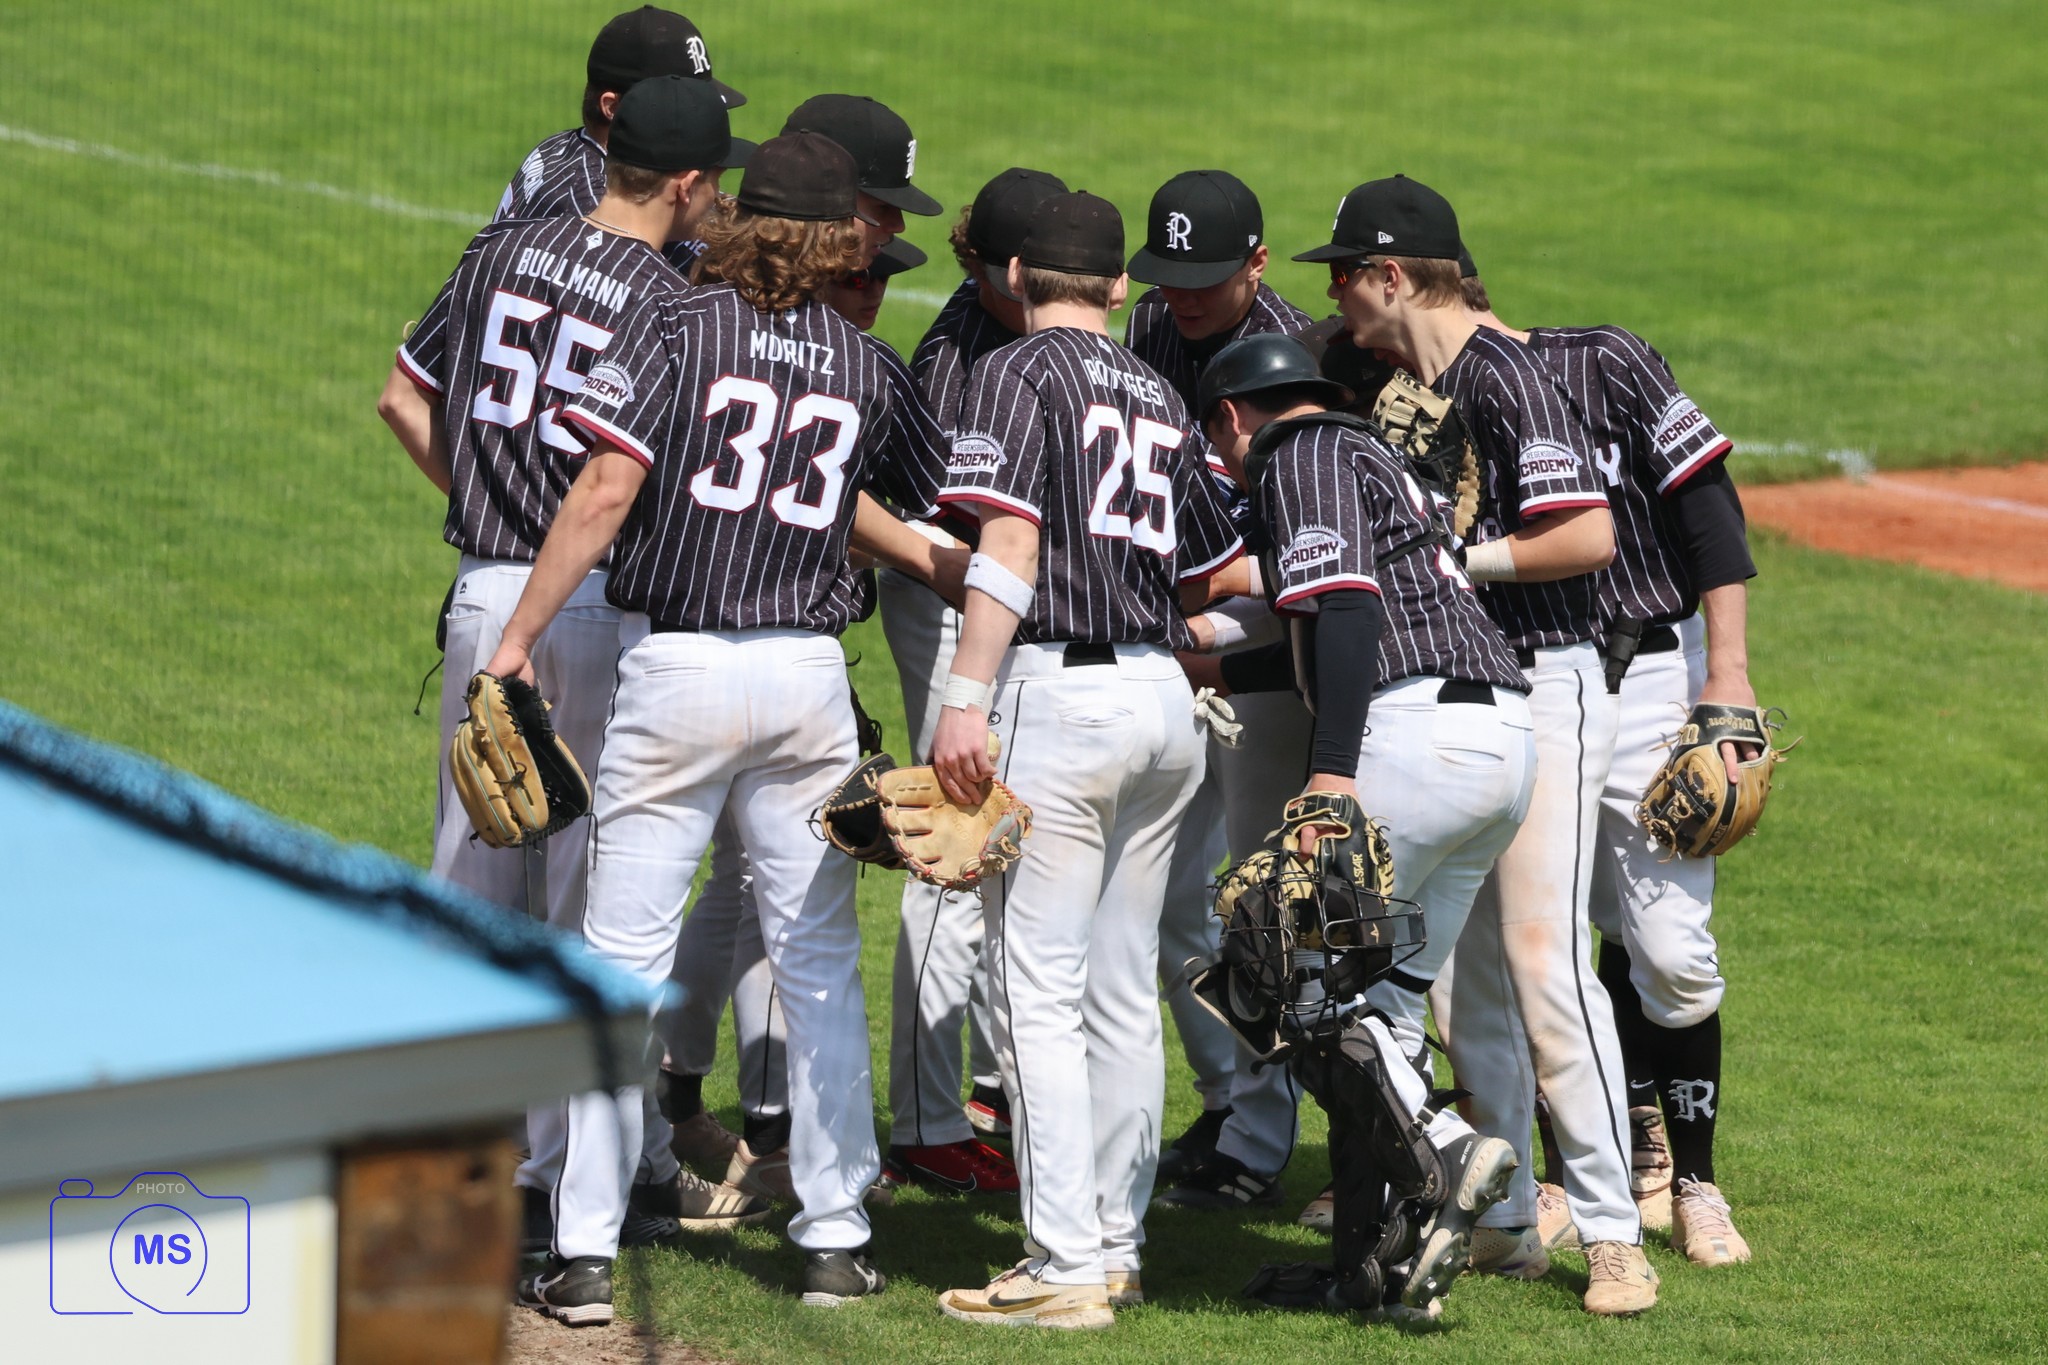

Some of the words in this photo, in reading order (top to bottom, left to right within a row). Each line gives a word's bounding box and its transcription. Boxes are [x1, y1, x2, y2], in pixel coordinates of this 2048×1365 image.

[1166, 212, 1192, 251] R
[515, 247, 632, 314] BULLMANN
[472, 288, 616, 458] 55
[749, 329, 835, 376] MORITZ
[581, 376, 629, 403] ADEMY
[1656, 408, 1705, 449] ACADE
[687, 372, 861, 532] 33
[947, 453, 1000, 468] CADEMY
[1519, 457, 1575, 479] CADEMY
[1081, 402, 1187, 558] 25
[1708, 716, 1756, 732] Wilson
[1352, 853, 1365, 887] L-STAR
[1668, 1078, 1716, 1122] R
